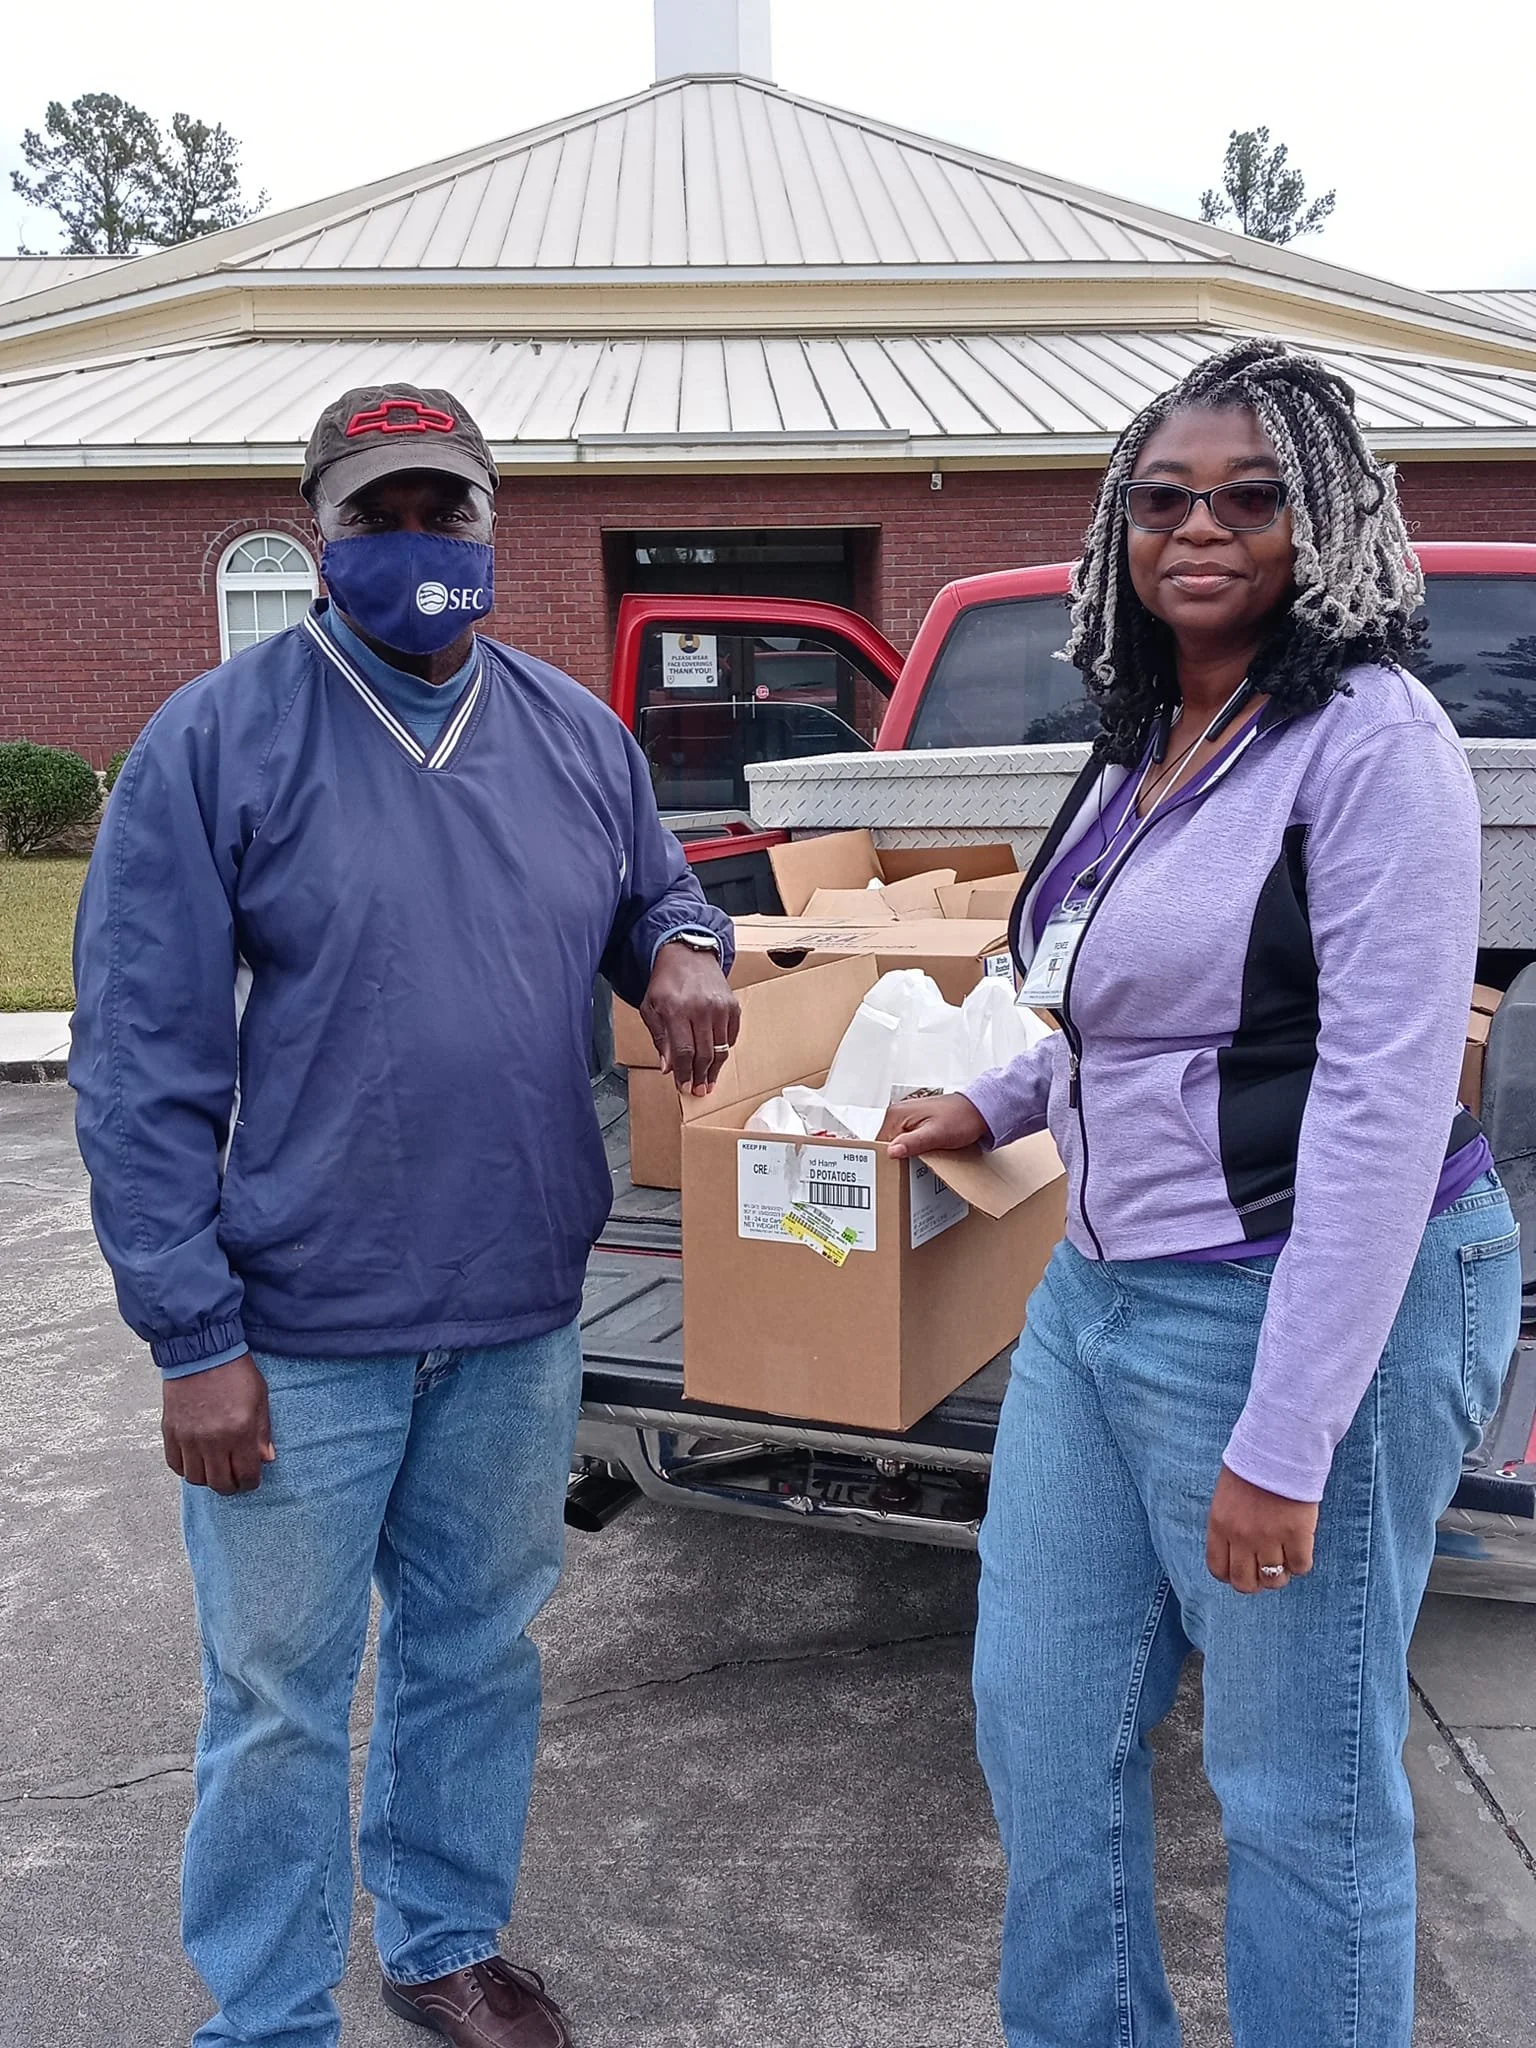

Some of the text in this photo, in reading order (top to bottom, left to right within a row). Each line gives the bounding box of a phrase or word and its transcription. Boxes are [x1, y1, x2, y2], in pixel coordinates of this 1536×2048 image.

[449, 588, 484, 610] SEC
[753, 1164, 769, 1175] CRE
[817, 1169, 857, 1183] POTATOES
